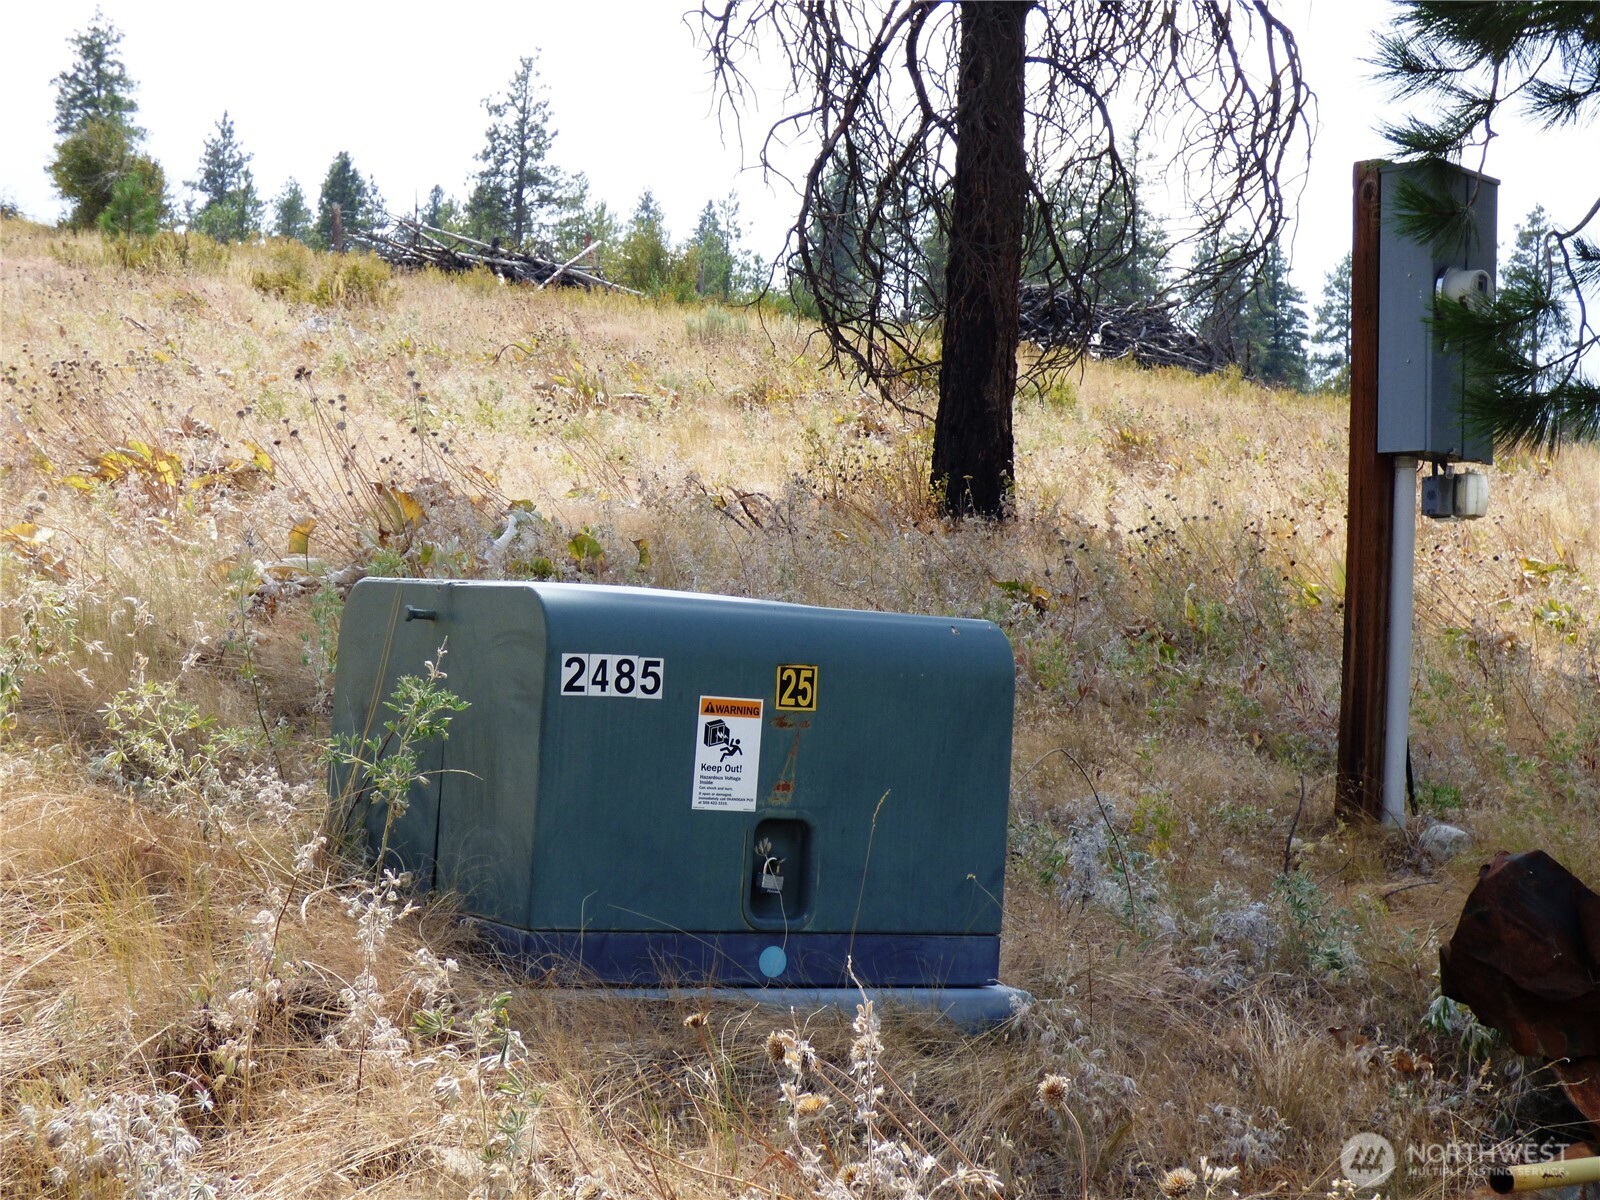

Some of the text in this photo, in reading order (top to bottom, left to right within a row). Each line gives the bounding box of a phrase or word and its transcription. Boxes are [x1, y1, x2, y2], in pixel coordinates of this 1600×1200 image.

[563, 656, 662, 695] 2485
[780, 668, 813, 706] 25
[715, 704, 760, 716] WARNING
[701, 763, 742, 773] Keep Out!
